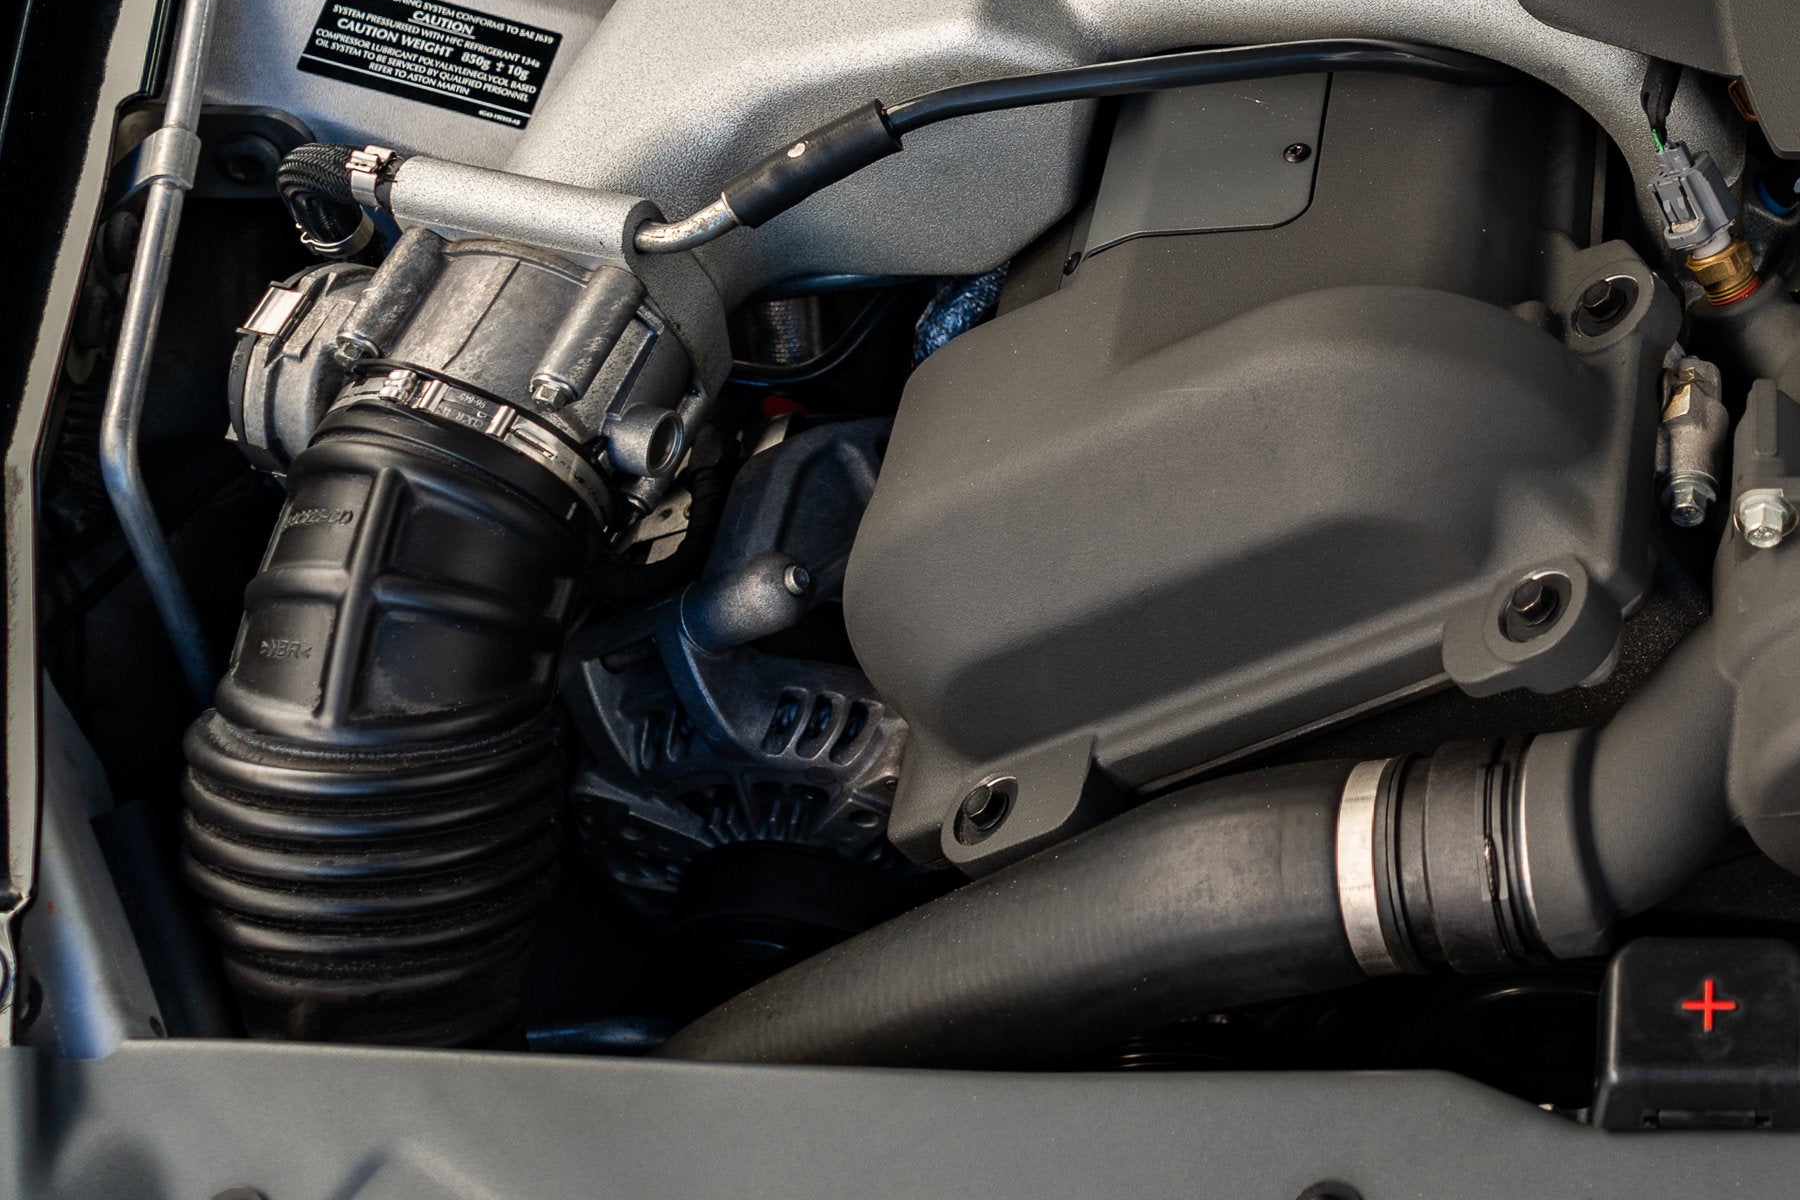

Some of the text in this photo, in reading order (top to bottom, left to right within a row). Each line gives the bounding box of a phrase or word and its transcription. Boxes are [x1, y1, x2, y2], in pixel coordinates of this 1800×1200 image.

[333, 4, 540, 68] SYSTEM PRESSURISED WITH HFC REFRIGERANT 134a
[337, 18, 530, 81] CAUTION WEIGHT 850g ± 10g
[412, 11, 475, 35] CAUTION
[422, 2, 455, 18] SYSTEM
[456, 11, 505, 31] CONFORMS
[506, 24, 519, 35] TO
[519, 29, 535, 40] SAE
[534, 35, 554, 45] J639
[315, 28, 537, 94] COMPRESSOR LUBRICANT POLYALKYLENEGLYCOL BASED
[315, 38, 529, 102] OIL SYSTEM TO BE SERVICED BY QUALIFIED PERSONNEL
[368, 62, 470, 96] REFER TO ASTON MARTIN
